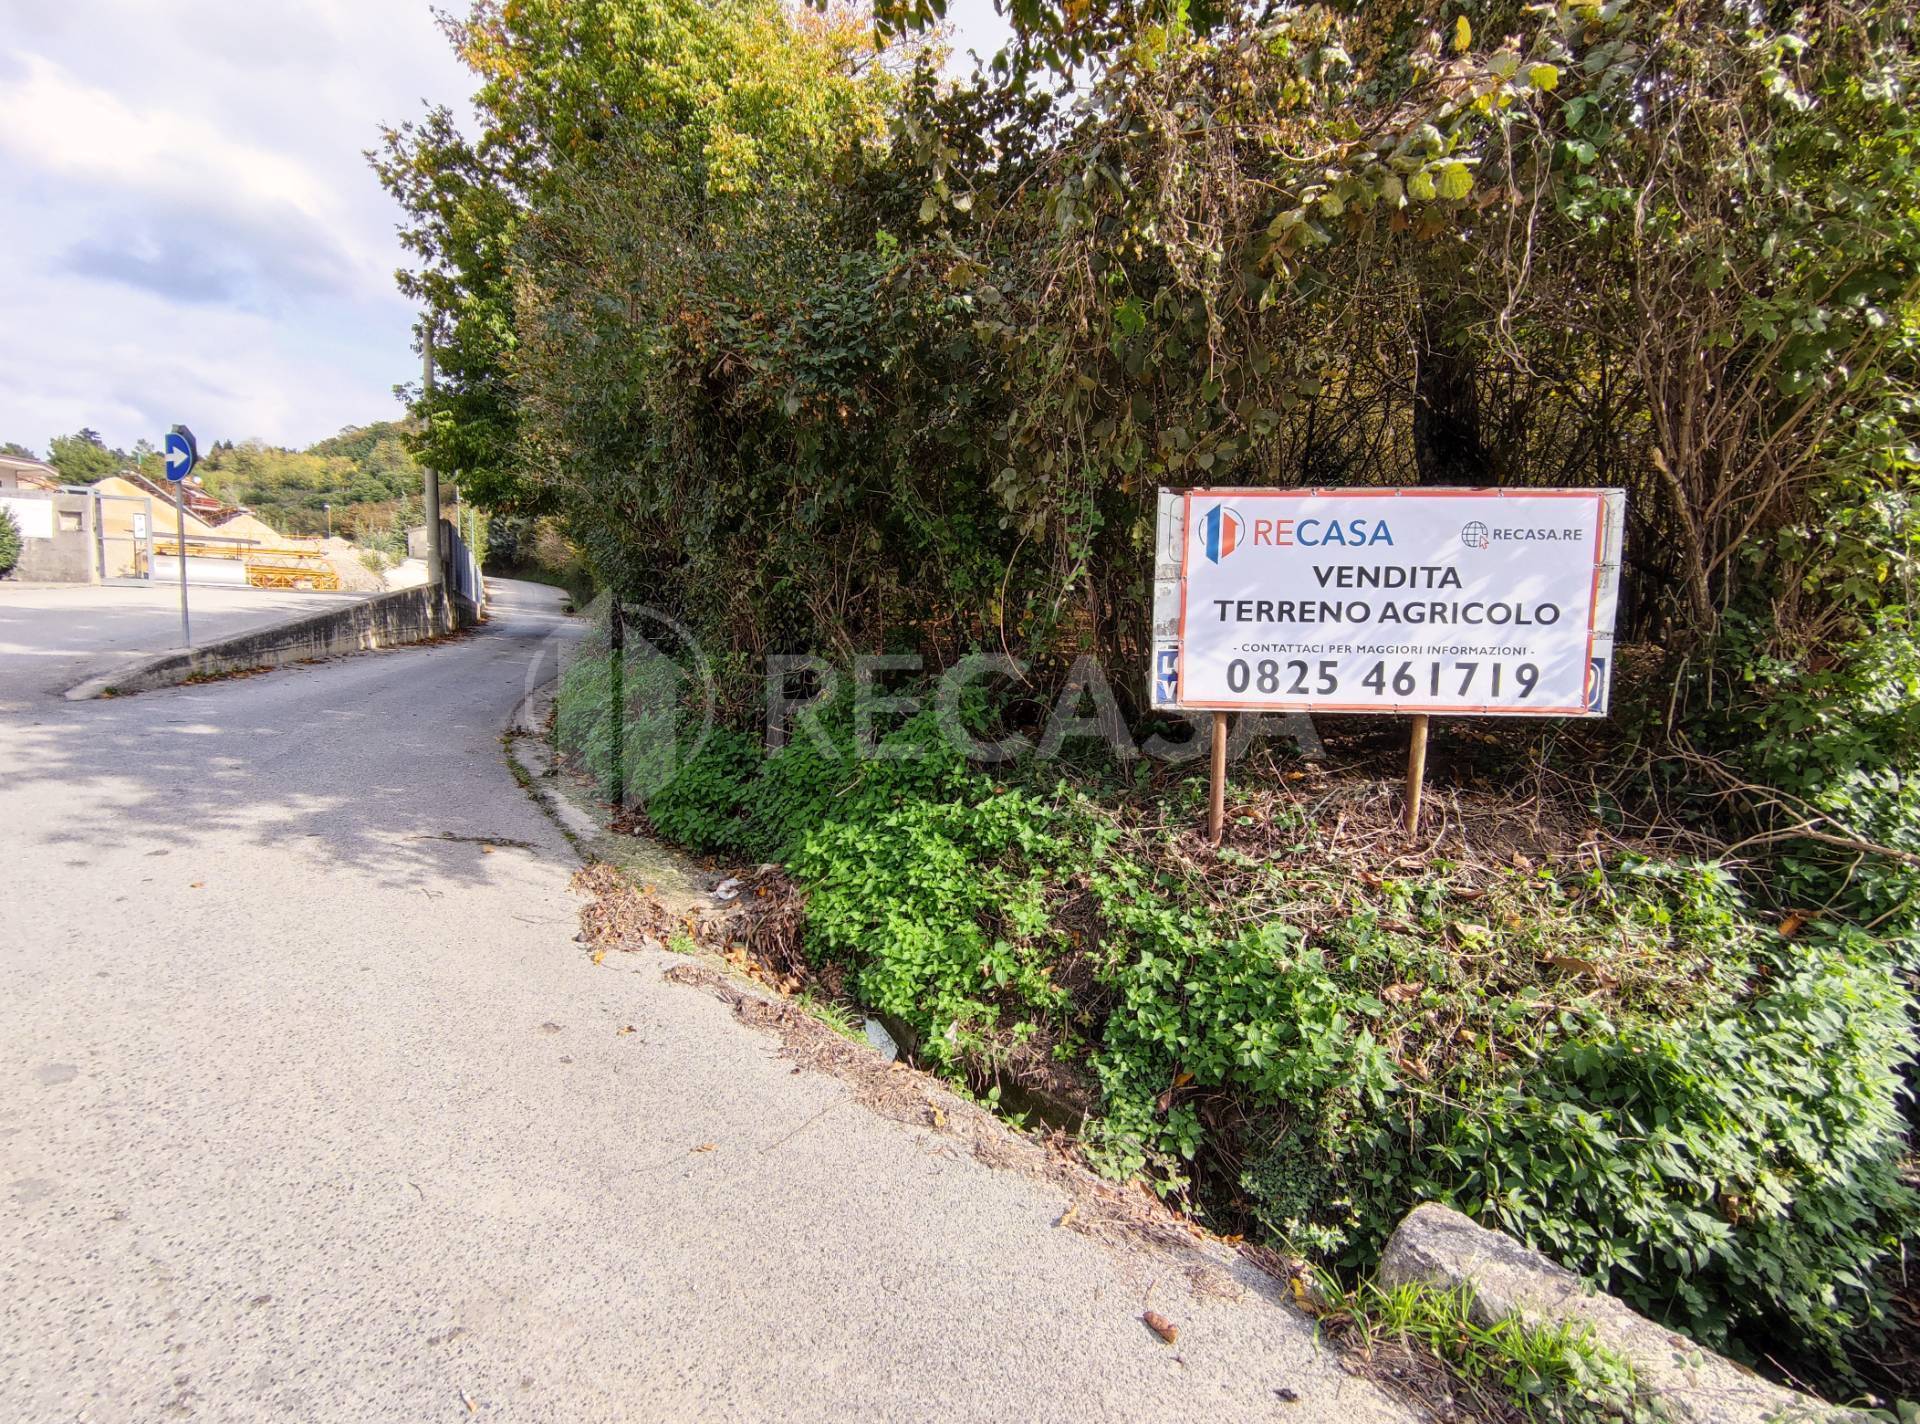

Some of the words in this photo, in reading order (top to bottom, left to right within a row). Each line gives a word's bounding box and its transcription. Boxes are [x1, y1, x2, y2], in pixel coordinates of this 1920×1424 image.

[1253, 518, 1395, 547] RECASA
[1493, 528, 1583, 541] RECASA.RE
[1312, 565, 1463, 589] VENDITA
[1213, 599, 1371, 624] TERRENO
[1378, 601, 1560, 626] AGRICOLO
[1241, 643, 1324, 653] CONTATTACI
[1328, 644, 1352, 654] PER
[1356, 645, 1422, 655] MAGGIORI
[1427, 646, 1527, 656] INFORMAZIONI
[1226, 658, 1339, 695] 0825
[1361, 660, 1540, 698] 461719
